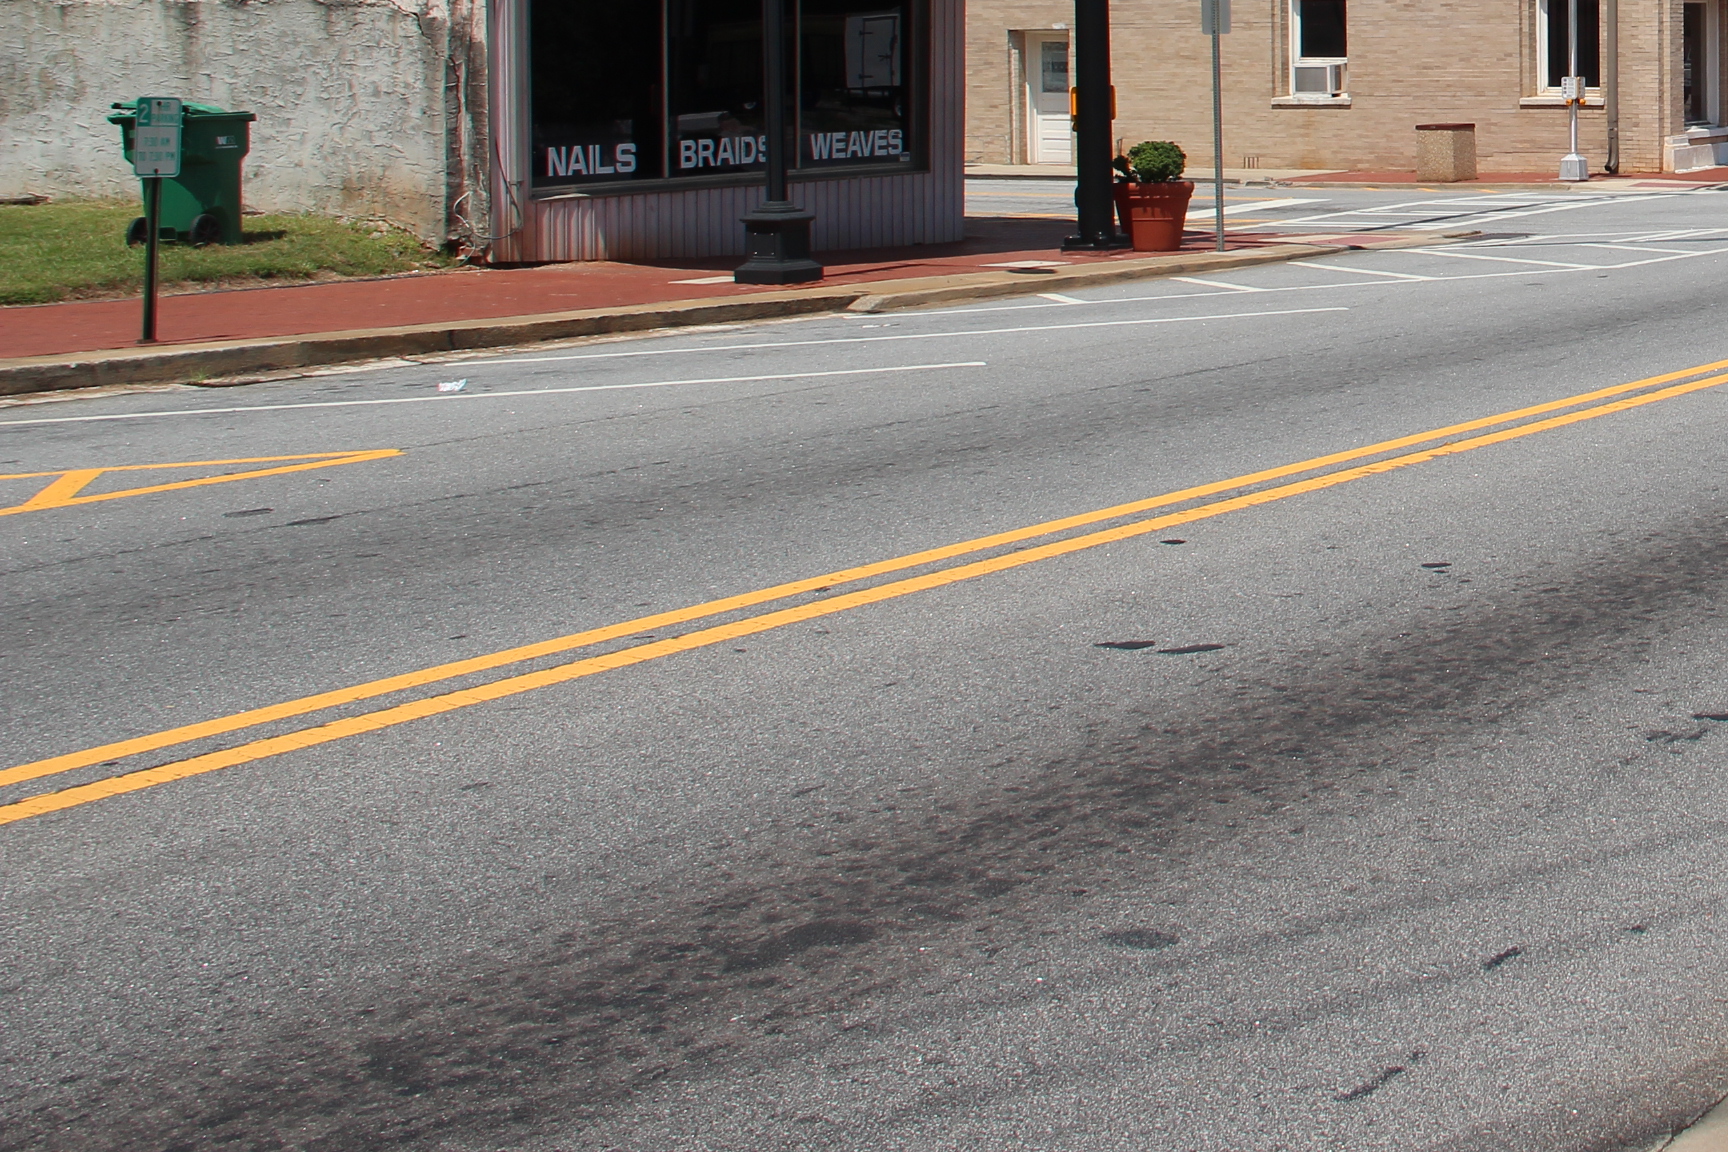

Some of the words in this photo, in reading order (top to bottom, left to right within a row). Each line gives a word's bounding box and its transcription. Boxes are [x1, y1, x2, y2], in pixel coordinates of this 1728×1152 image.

[139, 103, 149, 123] 2
[548, 143, 637, 177] NAILS
[810, 129, 903, 160] WEAVES
